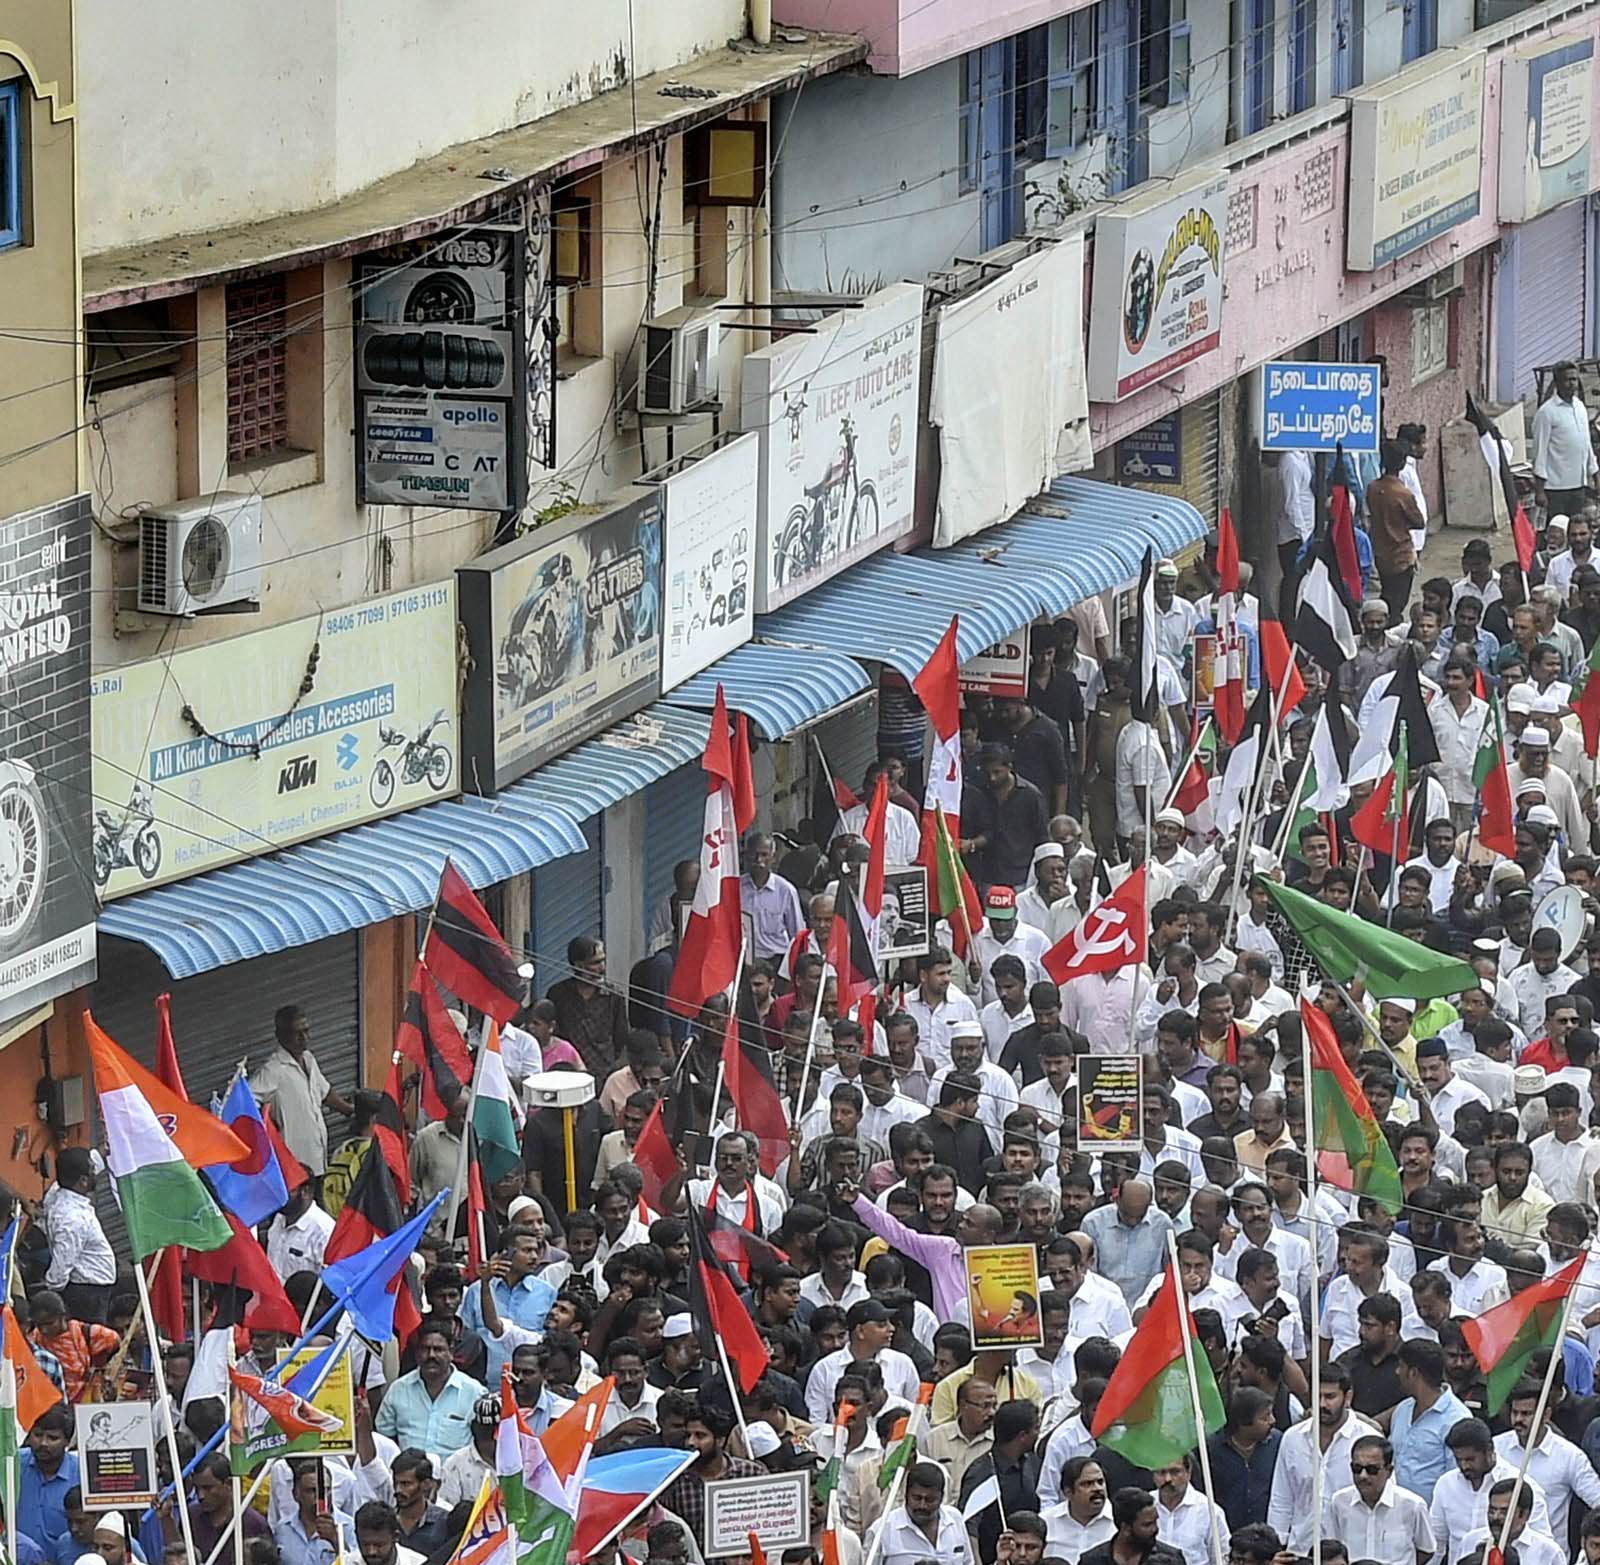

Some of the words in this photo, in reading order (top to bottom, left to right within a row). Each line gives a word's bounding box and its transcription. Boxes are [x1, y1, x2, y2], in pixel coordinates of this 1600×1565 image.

[854, 366, 883, 405] AUTO
[885, 352, 913, 385] CARE
[1270, 371, 1372, 400] நடைபாதை
[443, 407, 499, 426] apollo
[1267, 404, 1373, 442] நடப்பதற்கே
[380, 452, 433, 463] MICHELIN
[399, 475, 471, 493] TIMSUN
[326, 615, 355, 636] 98406
[356, 604, 385, 628] 77099
[391, 597, 419, 618] 97105
[420, 588, 449, 610] 31131
[154, 753, 172, 780] All
[175, 740, 206, 772] Kind
[207, 736, 225, 763] of
[225, 727, 254, 756] Two
[256, 711, 315, 751] Wheelers
[317, 690, 393, 732] Accessories
[277, 754, 318, 795] KTM
[310, 800, 350, 823] Chennai
